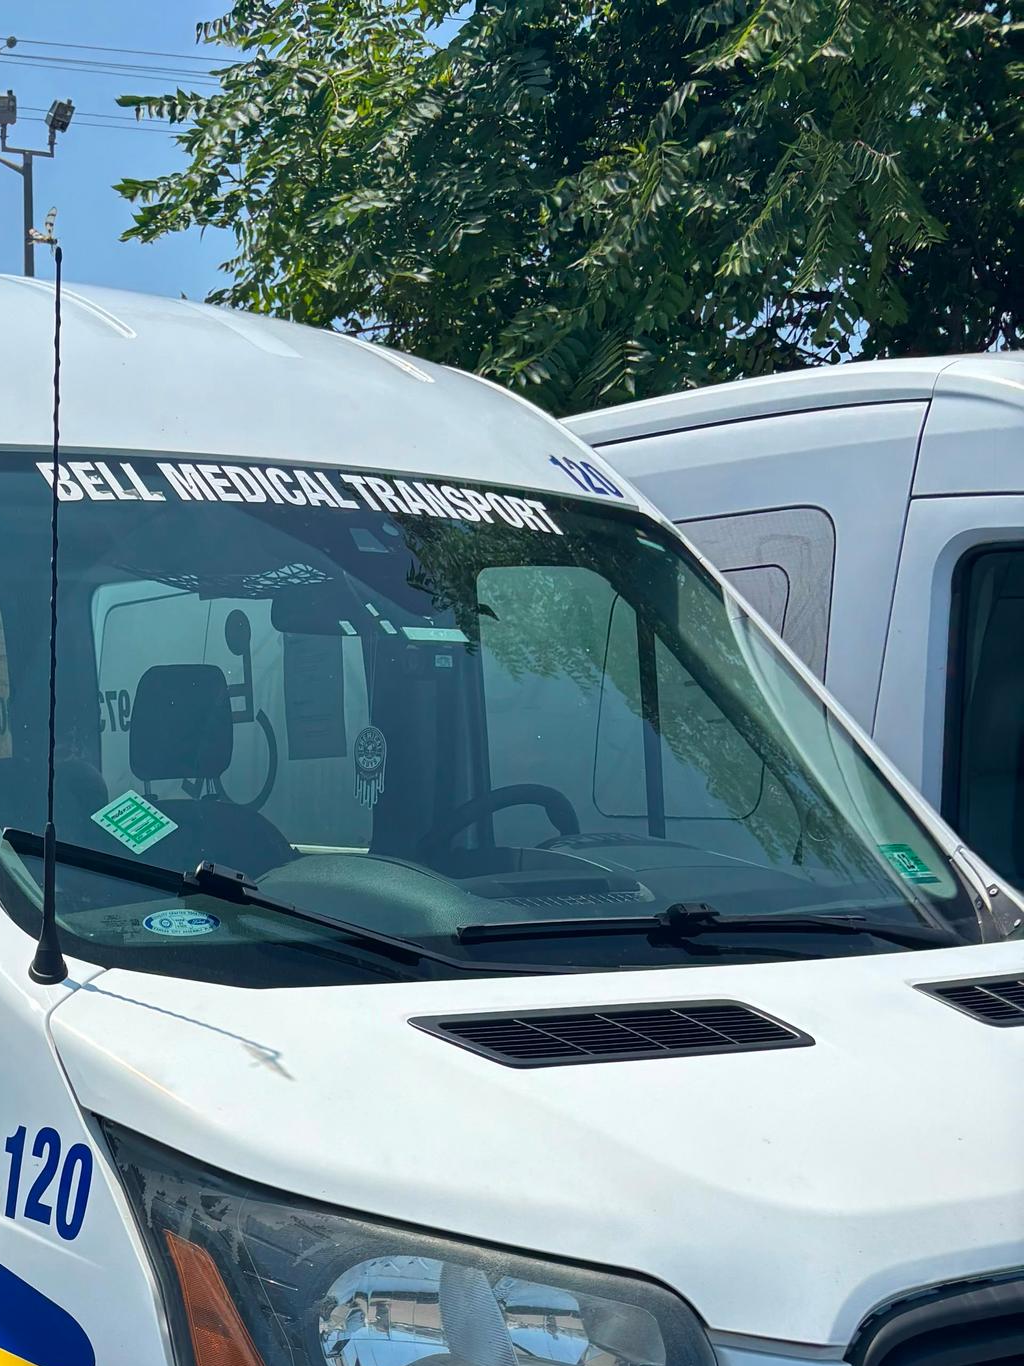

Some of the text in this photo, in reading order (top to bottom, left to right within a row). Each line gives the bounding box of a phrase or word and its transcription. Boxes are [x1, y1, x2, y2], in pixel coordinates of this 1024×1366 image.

[36, 462, 564, 536] BELL MEDICAL TRANSPORT
[549, 454, 625, 499] 120
[4, 1125, 94, 1241] 120
